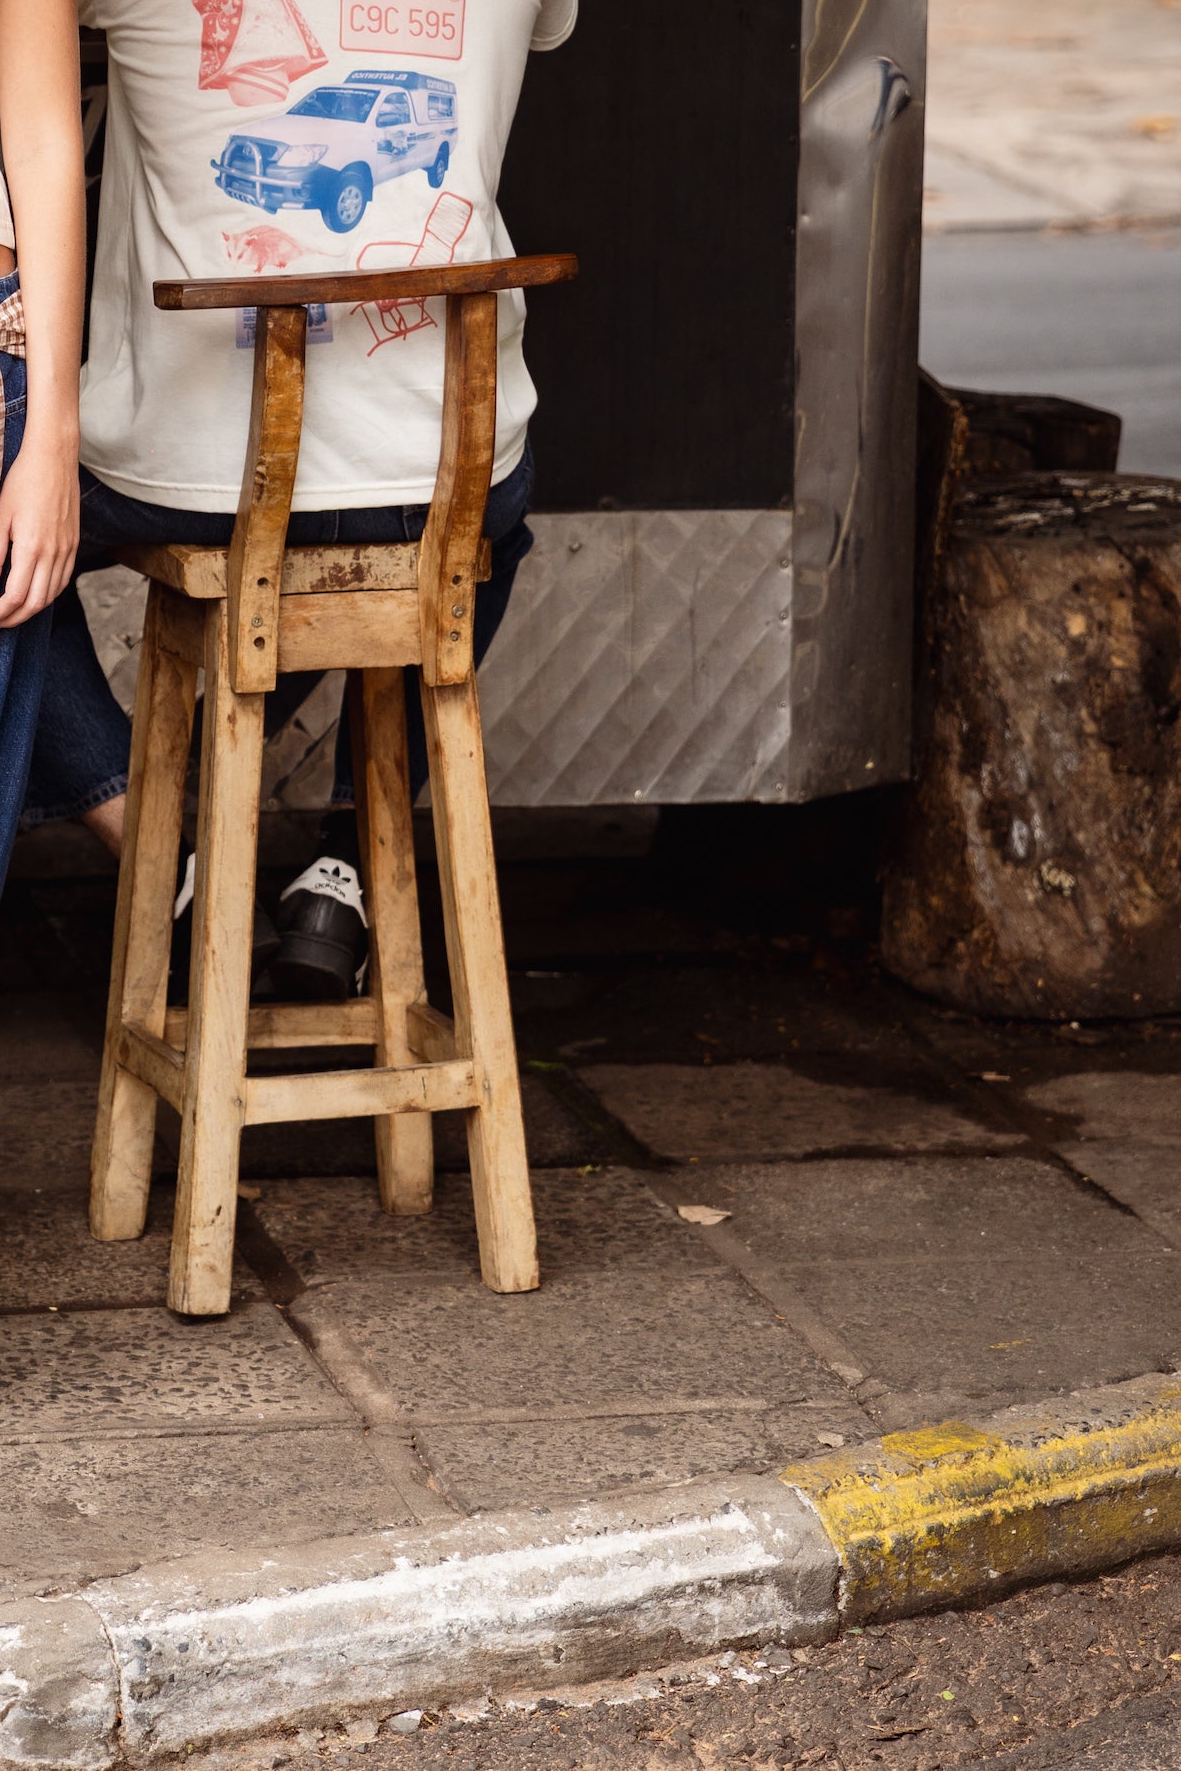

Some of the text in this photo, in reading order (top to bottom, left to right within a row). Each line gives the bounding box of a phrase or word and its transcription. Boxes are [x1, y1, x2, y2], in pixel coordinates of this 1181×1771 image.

[350, 4, 456, 40] C9C 595
[314, 882, 347, 899] adidas
